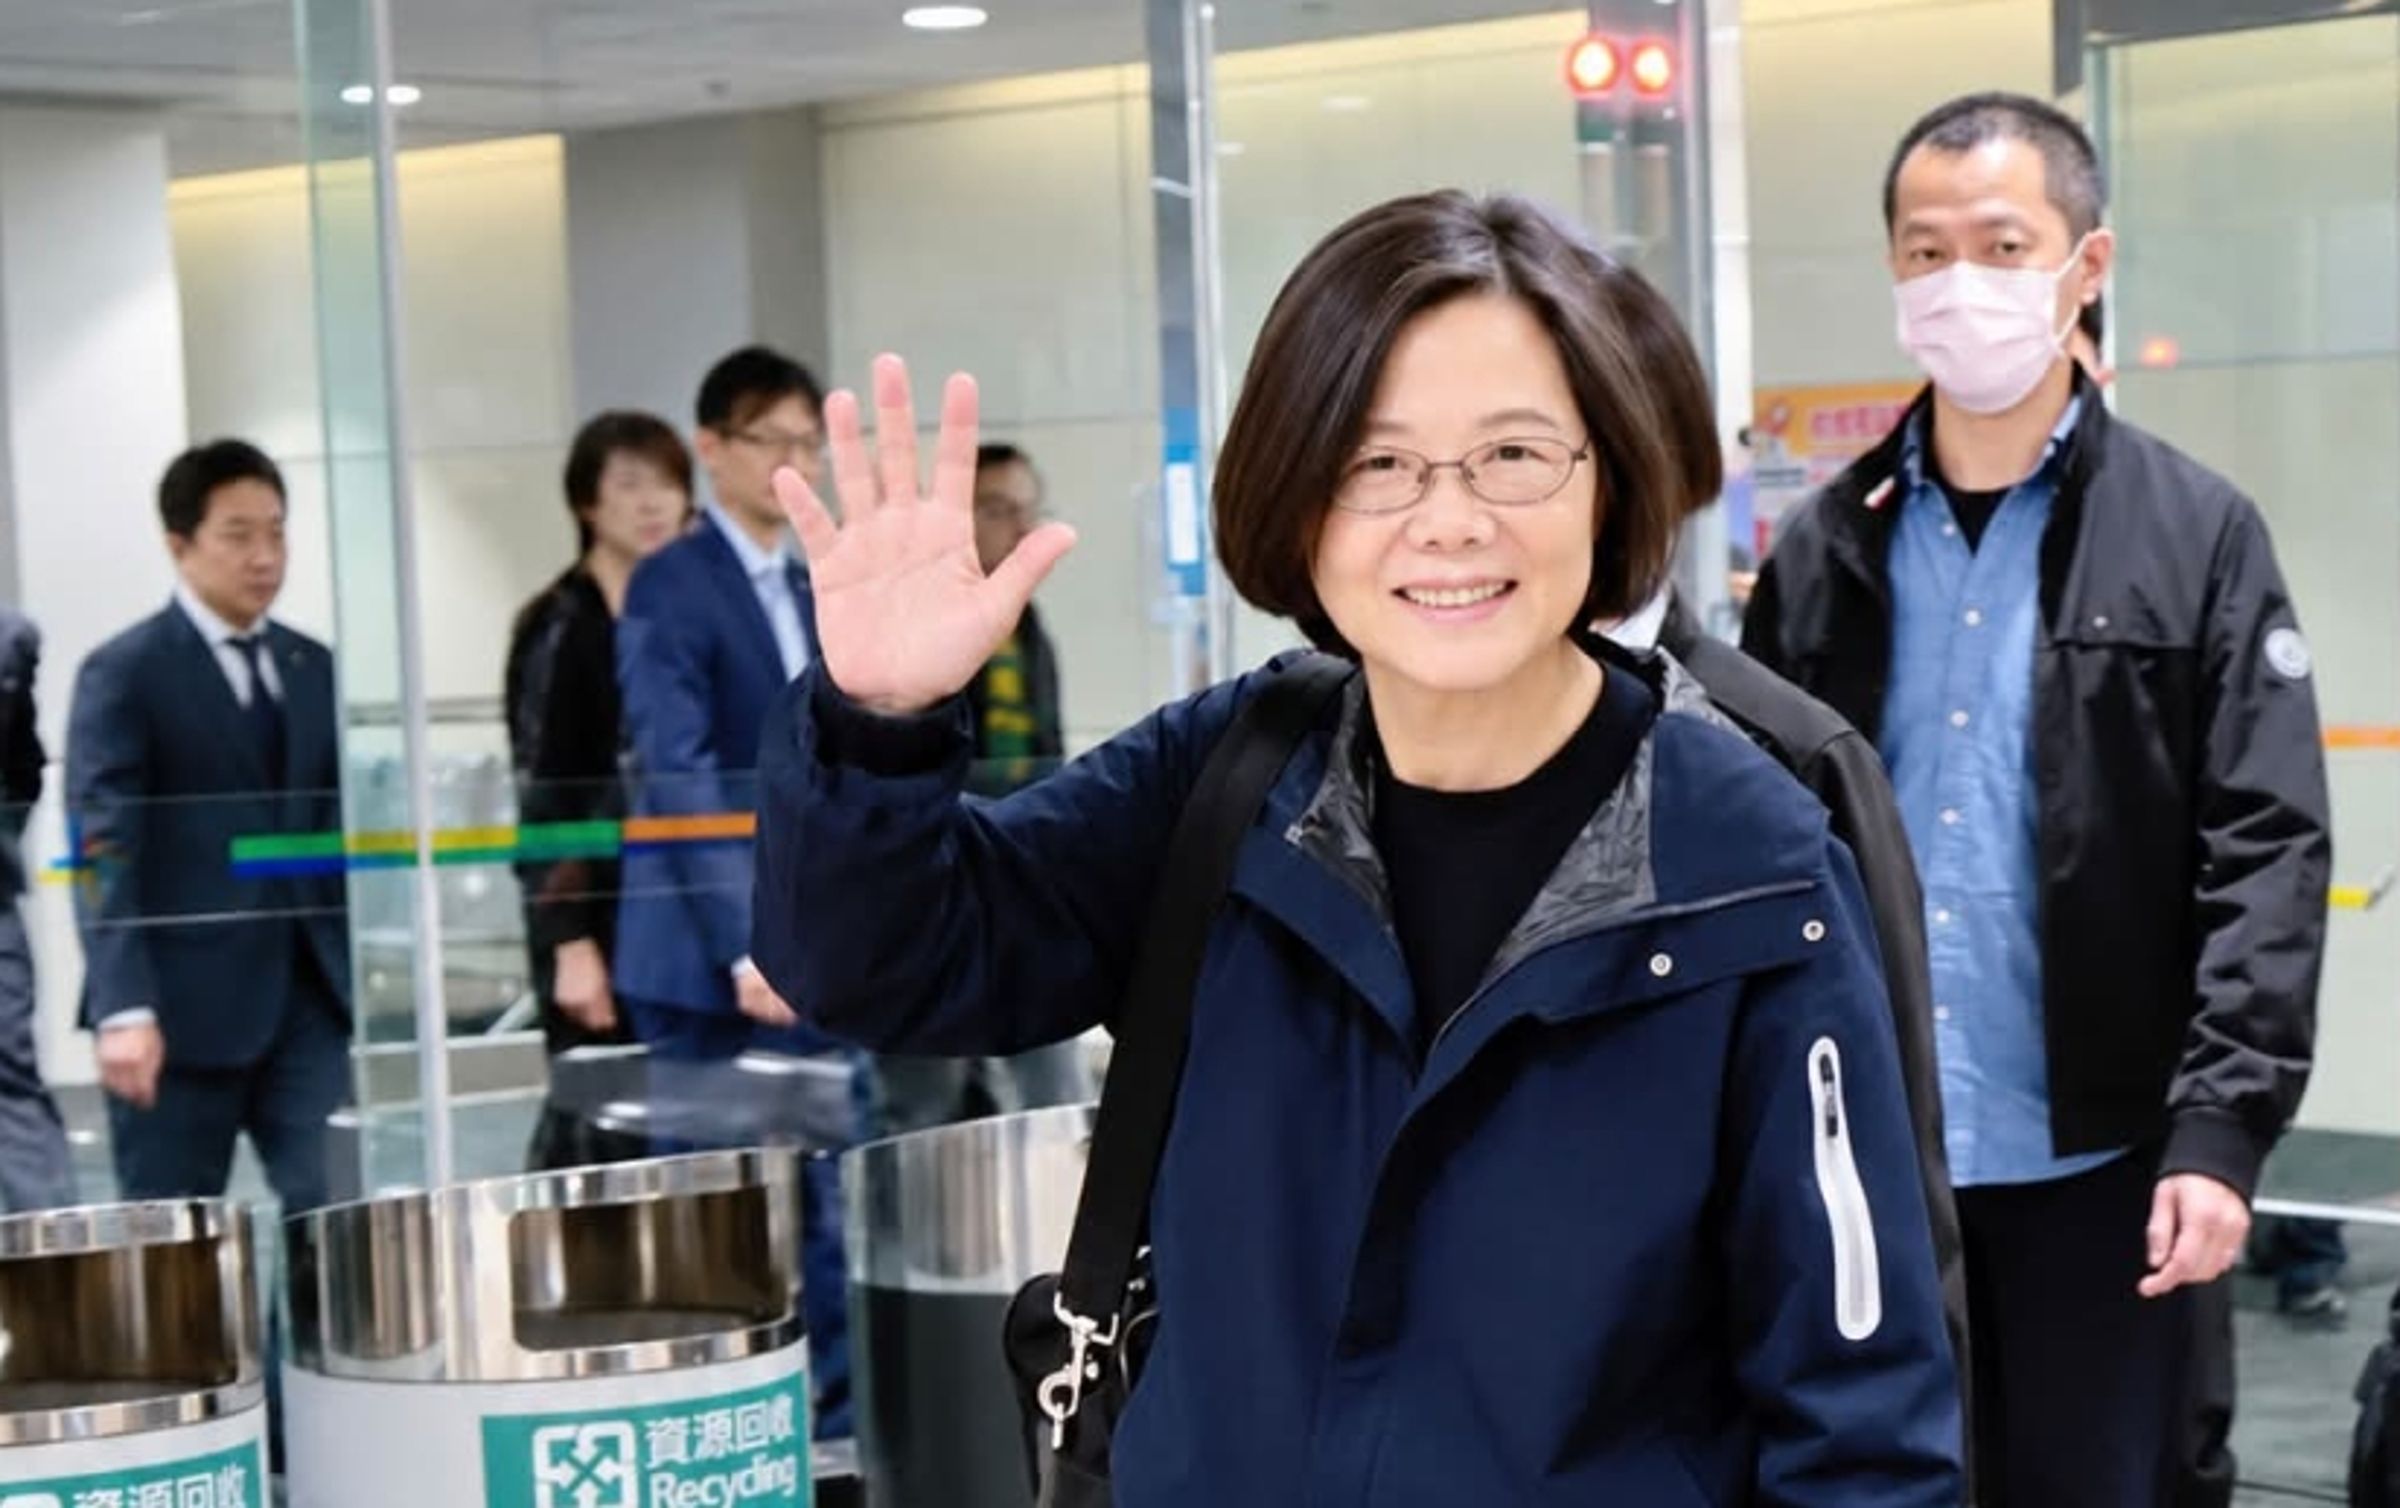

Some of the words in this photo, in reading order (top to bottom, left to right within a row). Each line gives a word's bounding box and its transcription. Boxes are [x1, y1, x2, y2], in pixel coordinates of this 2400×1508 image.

[645, 1393, 794, 1470] 資源回收
[651, 1454, 796, 1508] Recycling
